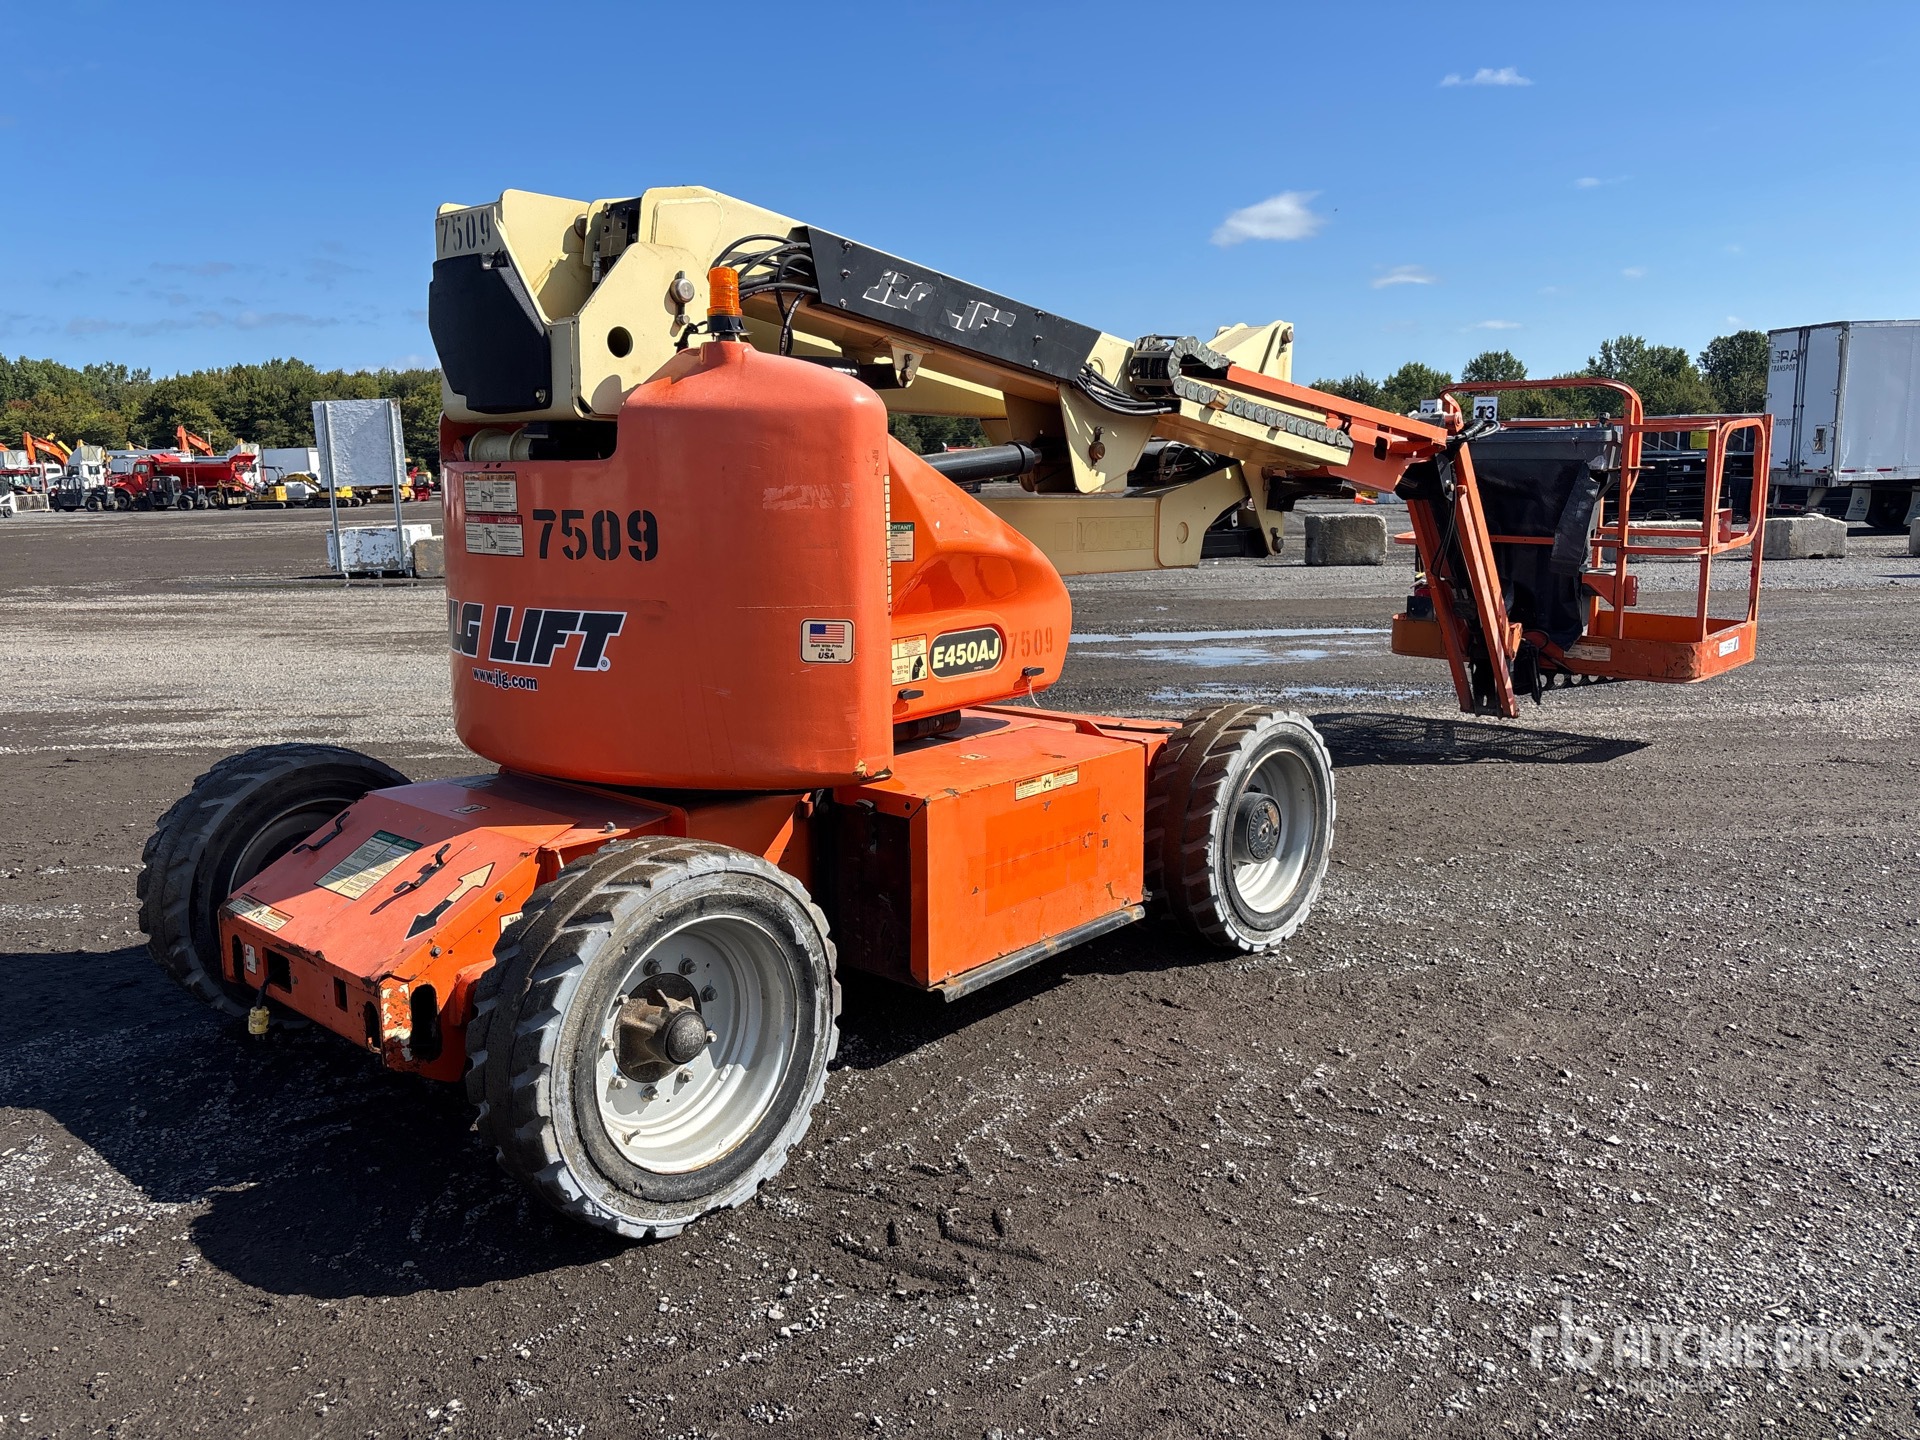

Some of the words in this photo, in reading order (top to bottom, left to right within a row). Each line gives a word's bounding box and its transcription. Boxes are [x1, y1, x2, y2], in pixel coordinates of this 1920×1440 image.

[440, 211, 491, 252] 7509
[532, 509, 659, 562] 7509
[450, 599, 485, 658] LG
[488, 605, 627, 671] LIFT
[932, 637, 1000, 670] E450AJ
[1008, 626, 1054, 660] 7509
[472, 667, 538, 691] www.jlg.com
